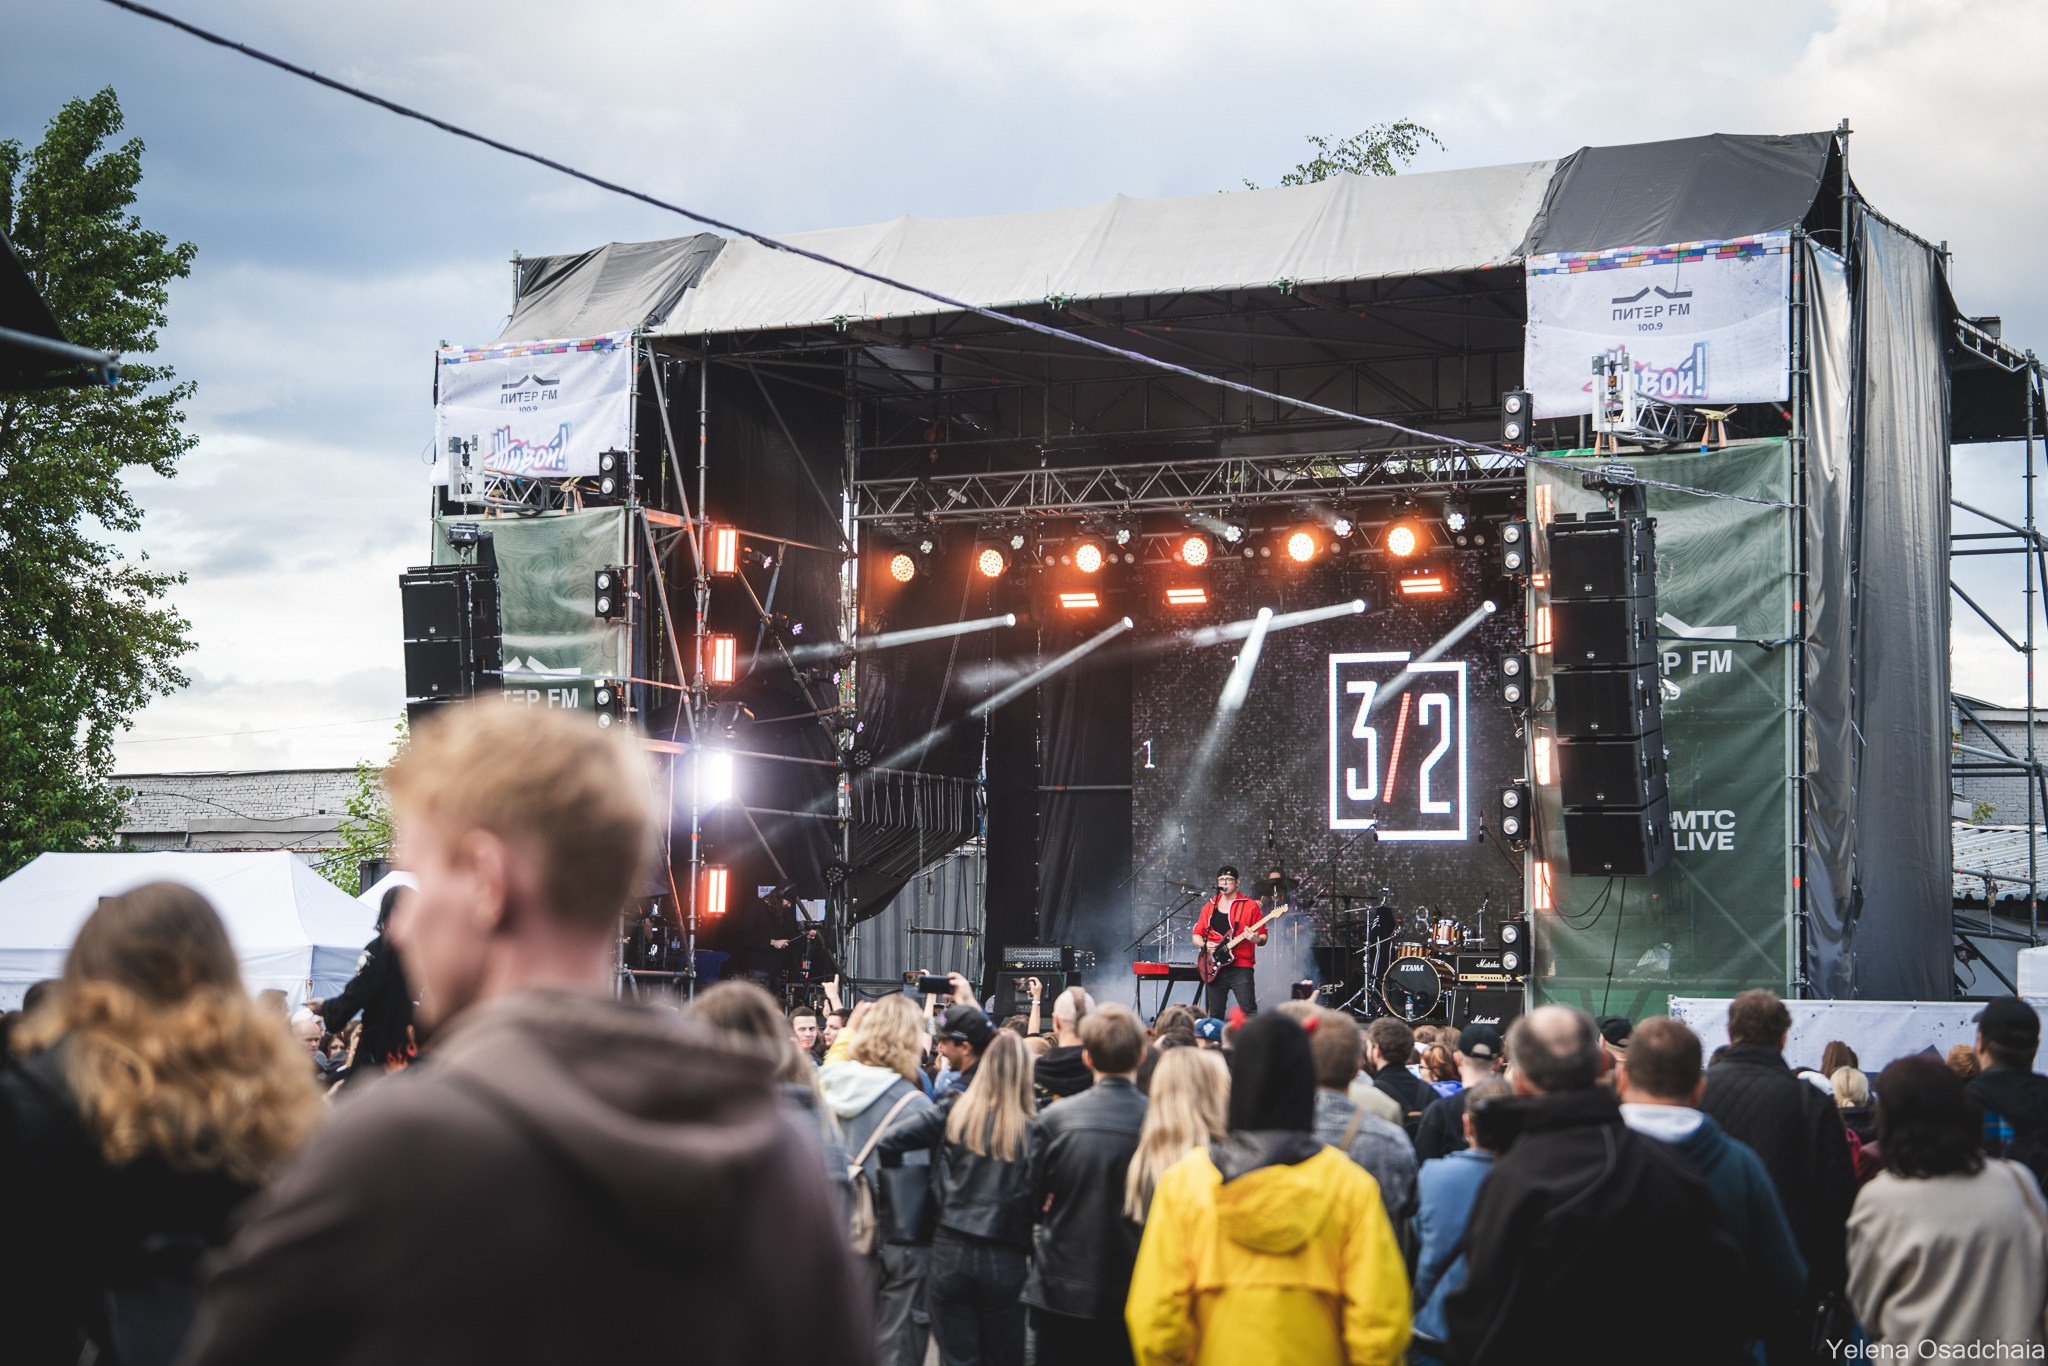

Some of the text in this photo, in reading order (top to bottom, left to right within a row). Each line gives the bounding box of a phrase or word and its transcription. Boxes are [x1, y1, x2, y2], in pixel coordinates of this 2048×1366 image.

[1612, 303, 1691, 321] ПИТЕР FM
[1637, 322, 1663, 332] 100.9
[500, 389, 558, 404] ПИТЕР FM
[519, 405, 538, 413] 100.9
[1692, 649, 1733, 675] FM
[547, 687, 579, 709] FM
[1143, 740, 1155, 769] 1
[1346, 680, 1451, 814] 3/2
[1673, 831, 1735, 851] LIVE
[1471, 1015, 1500, 1025] Marshall
